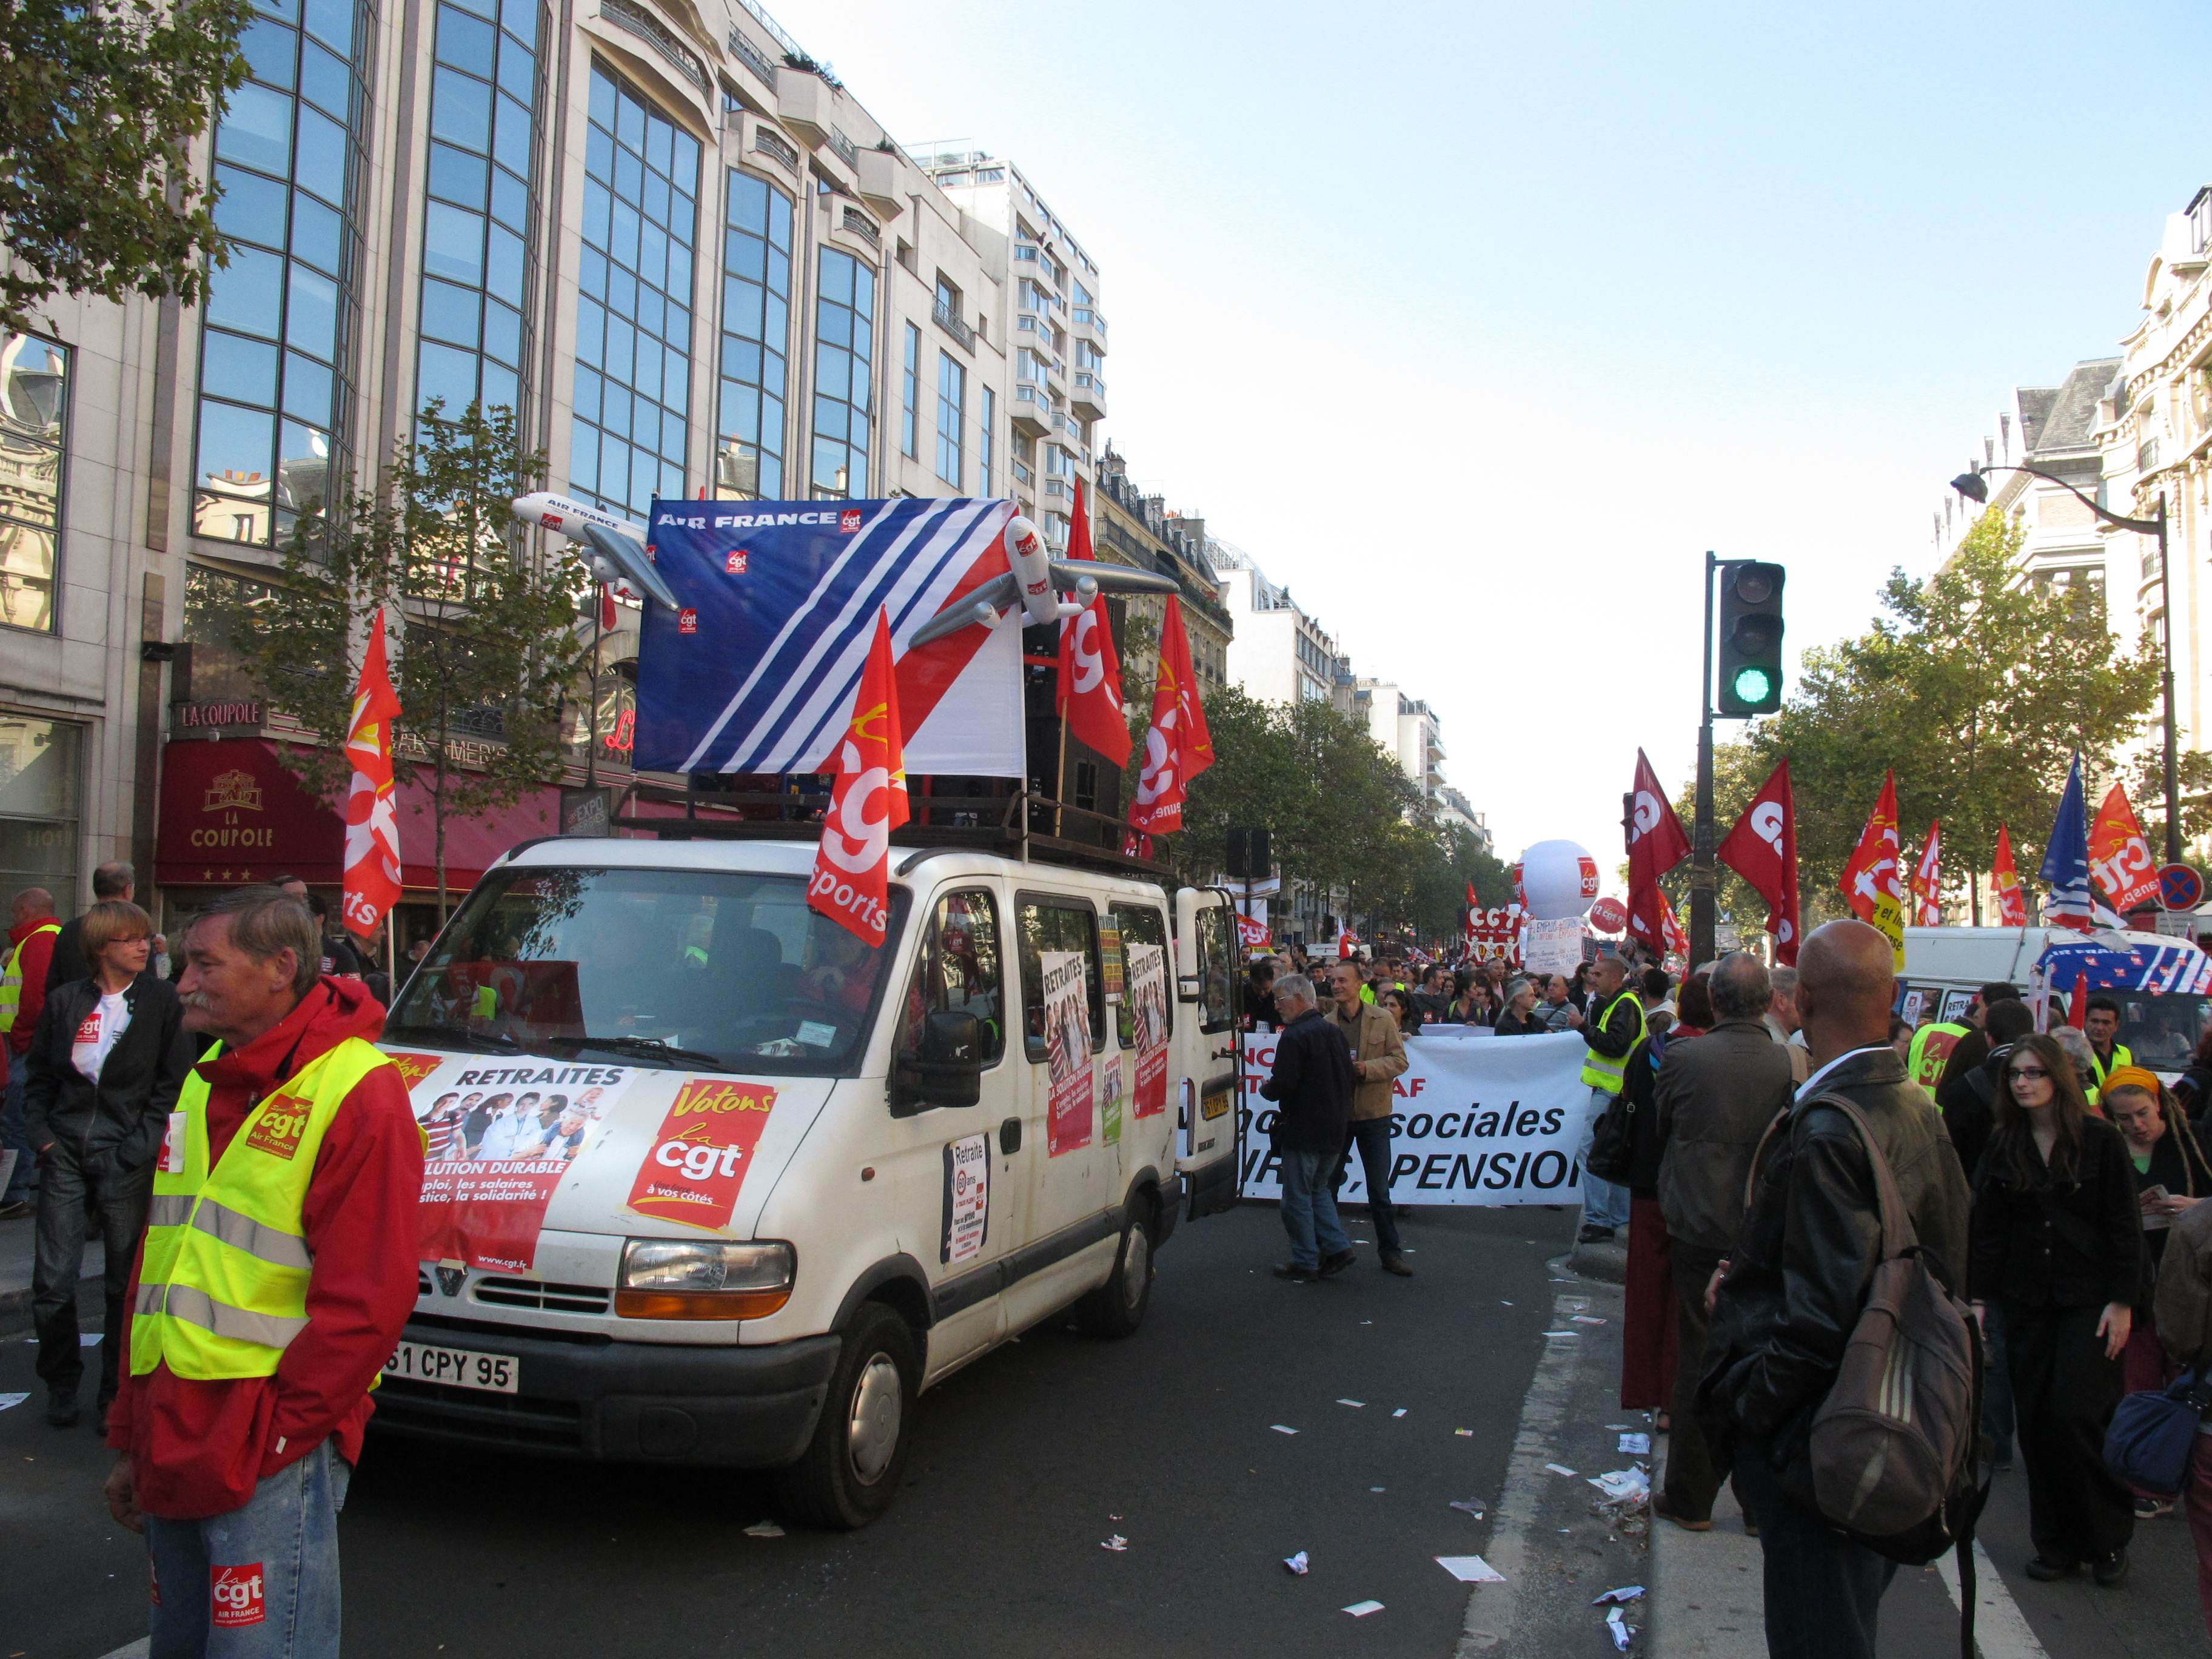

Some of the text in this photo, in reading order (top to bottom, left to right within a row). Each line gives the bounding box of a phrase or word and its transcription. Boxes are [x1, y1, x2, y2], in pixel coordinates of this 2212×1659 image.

[548, 499, 619, 529] AIR FRANCE
[714, 512, 837, 528] FRANCE
[183, 703, 259, 726] LA COUPOLE
[225, 811, 238, 825] LA
[190, 828, 272, 846] COUPOLE
[1469, 907, 1520, 929] CGT
[1132, 948, 1161, 981] RETRAITES
[1044, 955, 1082, 996] RETRAITES
[455, 1068, 625, 1086] RETRAITES
[673, 1084, 774, 1117] Votons
[260, 1113, 306, 1139] cgt
[1390, 1101, 1565, 1138] sociales
[250, 1131, 294, 1151] Air France
[655, 1141, 743, 1181] cgt
[955, 1143, 983, 1167] Retraite
[424, 1161, 566, 1176] LUTION DURABLE
[456, 1178, 475, 1190] les
[479, 1178, 534, 1190] salaires
[967, 1175, 976, 1186] ans
[455, 1190, 468, 1201] la
[472, 1188, 537, 1201] solidarité
[646, 1184, 714, 1205] à vos côtés
[478, 1255, 528, 1269] www.cgt.fr
[421, 1349, 468, 1381] CPY
[477, 1357, 510, 1387] 95
[213, 1575, 263, 1609] cgt
[231, 1606, 260, 1618] FRANCE
